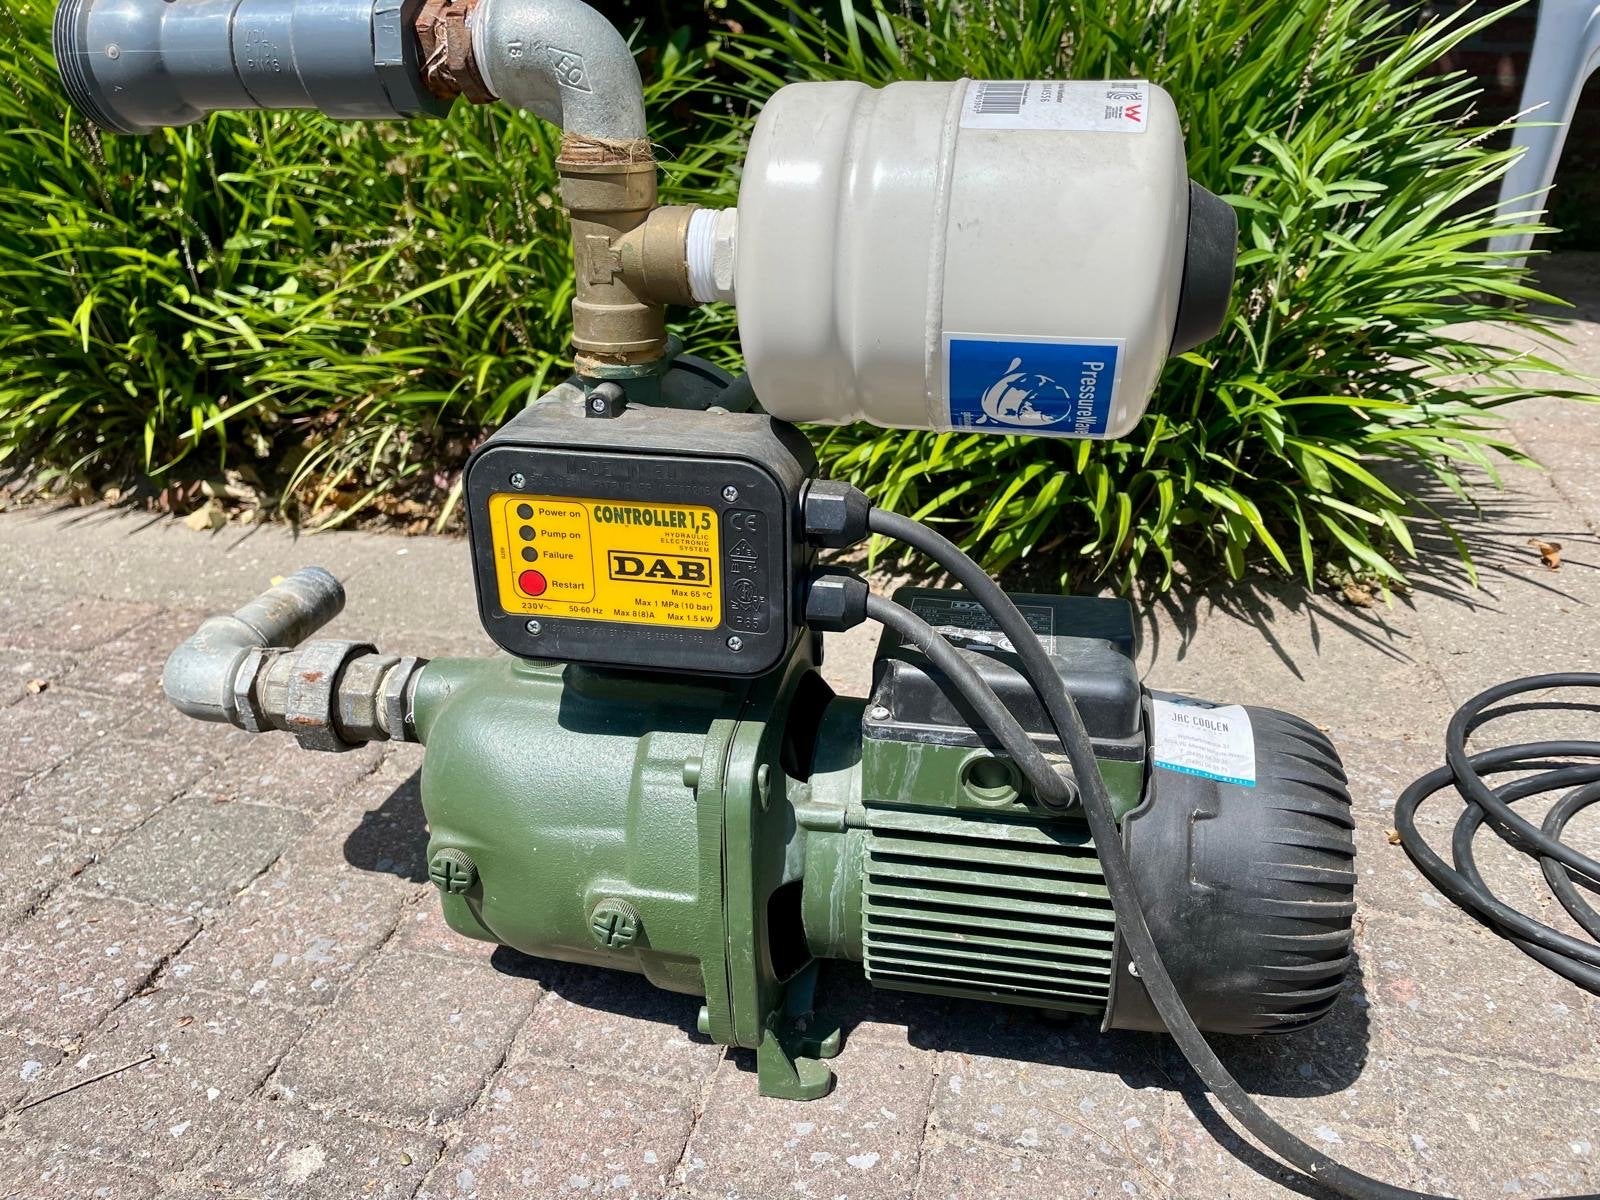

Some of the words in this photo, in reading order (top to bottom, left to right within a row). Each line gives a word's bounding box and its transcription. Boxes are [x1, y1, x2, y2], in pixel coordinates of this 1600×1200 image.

[1074, 361, 1105, 436] PressureWave
[539, 507, 566, 517] Power
[593, 505, 687, 529] CONTROLLER
[688, 511, 711, 534] 1,5
[541, 529, 567, 539] Pump
[664, 532, 709, 541] HYDRAULIC
[660, 538, 709, 547] ELECTRONIC
[679, 545, 710, 553] SYSTEM
[543, 551, 574, 559] Failure
[613, 556, 706, 582] DAB
[551, 580, 585, 590] Restart
[671, 589, 688, 597] Max
[690, 590, 700, 598] 65
[634, 598, 652, 607] Max
[661, 601, 679, 609] MPa
[681, 602, 694, 610] (10
[696, 603, 713, 612] bar)
[952, 601, 986, 611] DA
[569, 605, 591, 614] 50-60
[613, 609, 631, 617] Max
[632, 610, 655, 619] 8(8)A
[667, 613, 684, 621] Max
[686, 614, 698, 622] 1.5
[700, 615, 714, 623] kW
[1171, 713, 1190, 724] JAC
[1192, 716, 1230, 733] COOLEN
